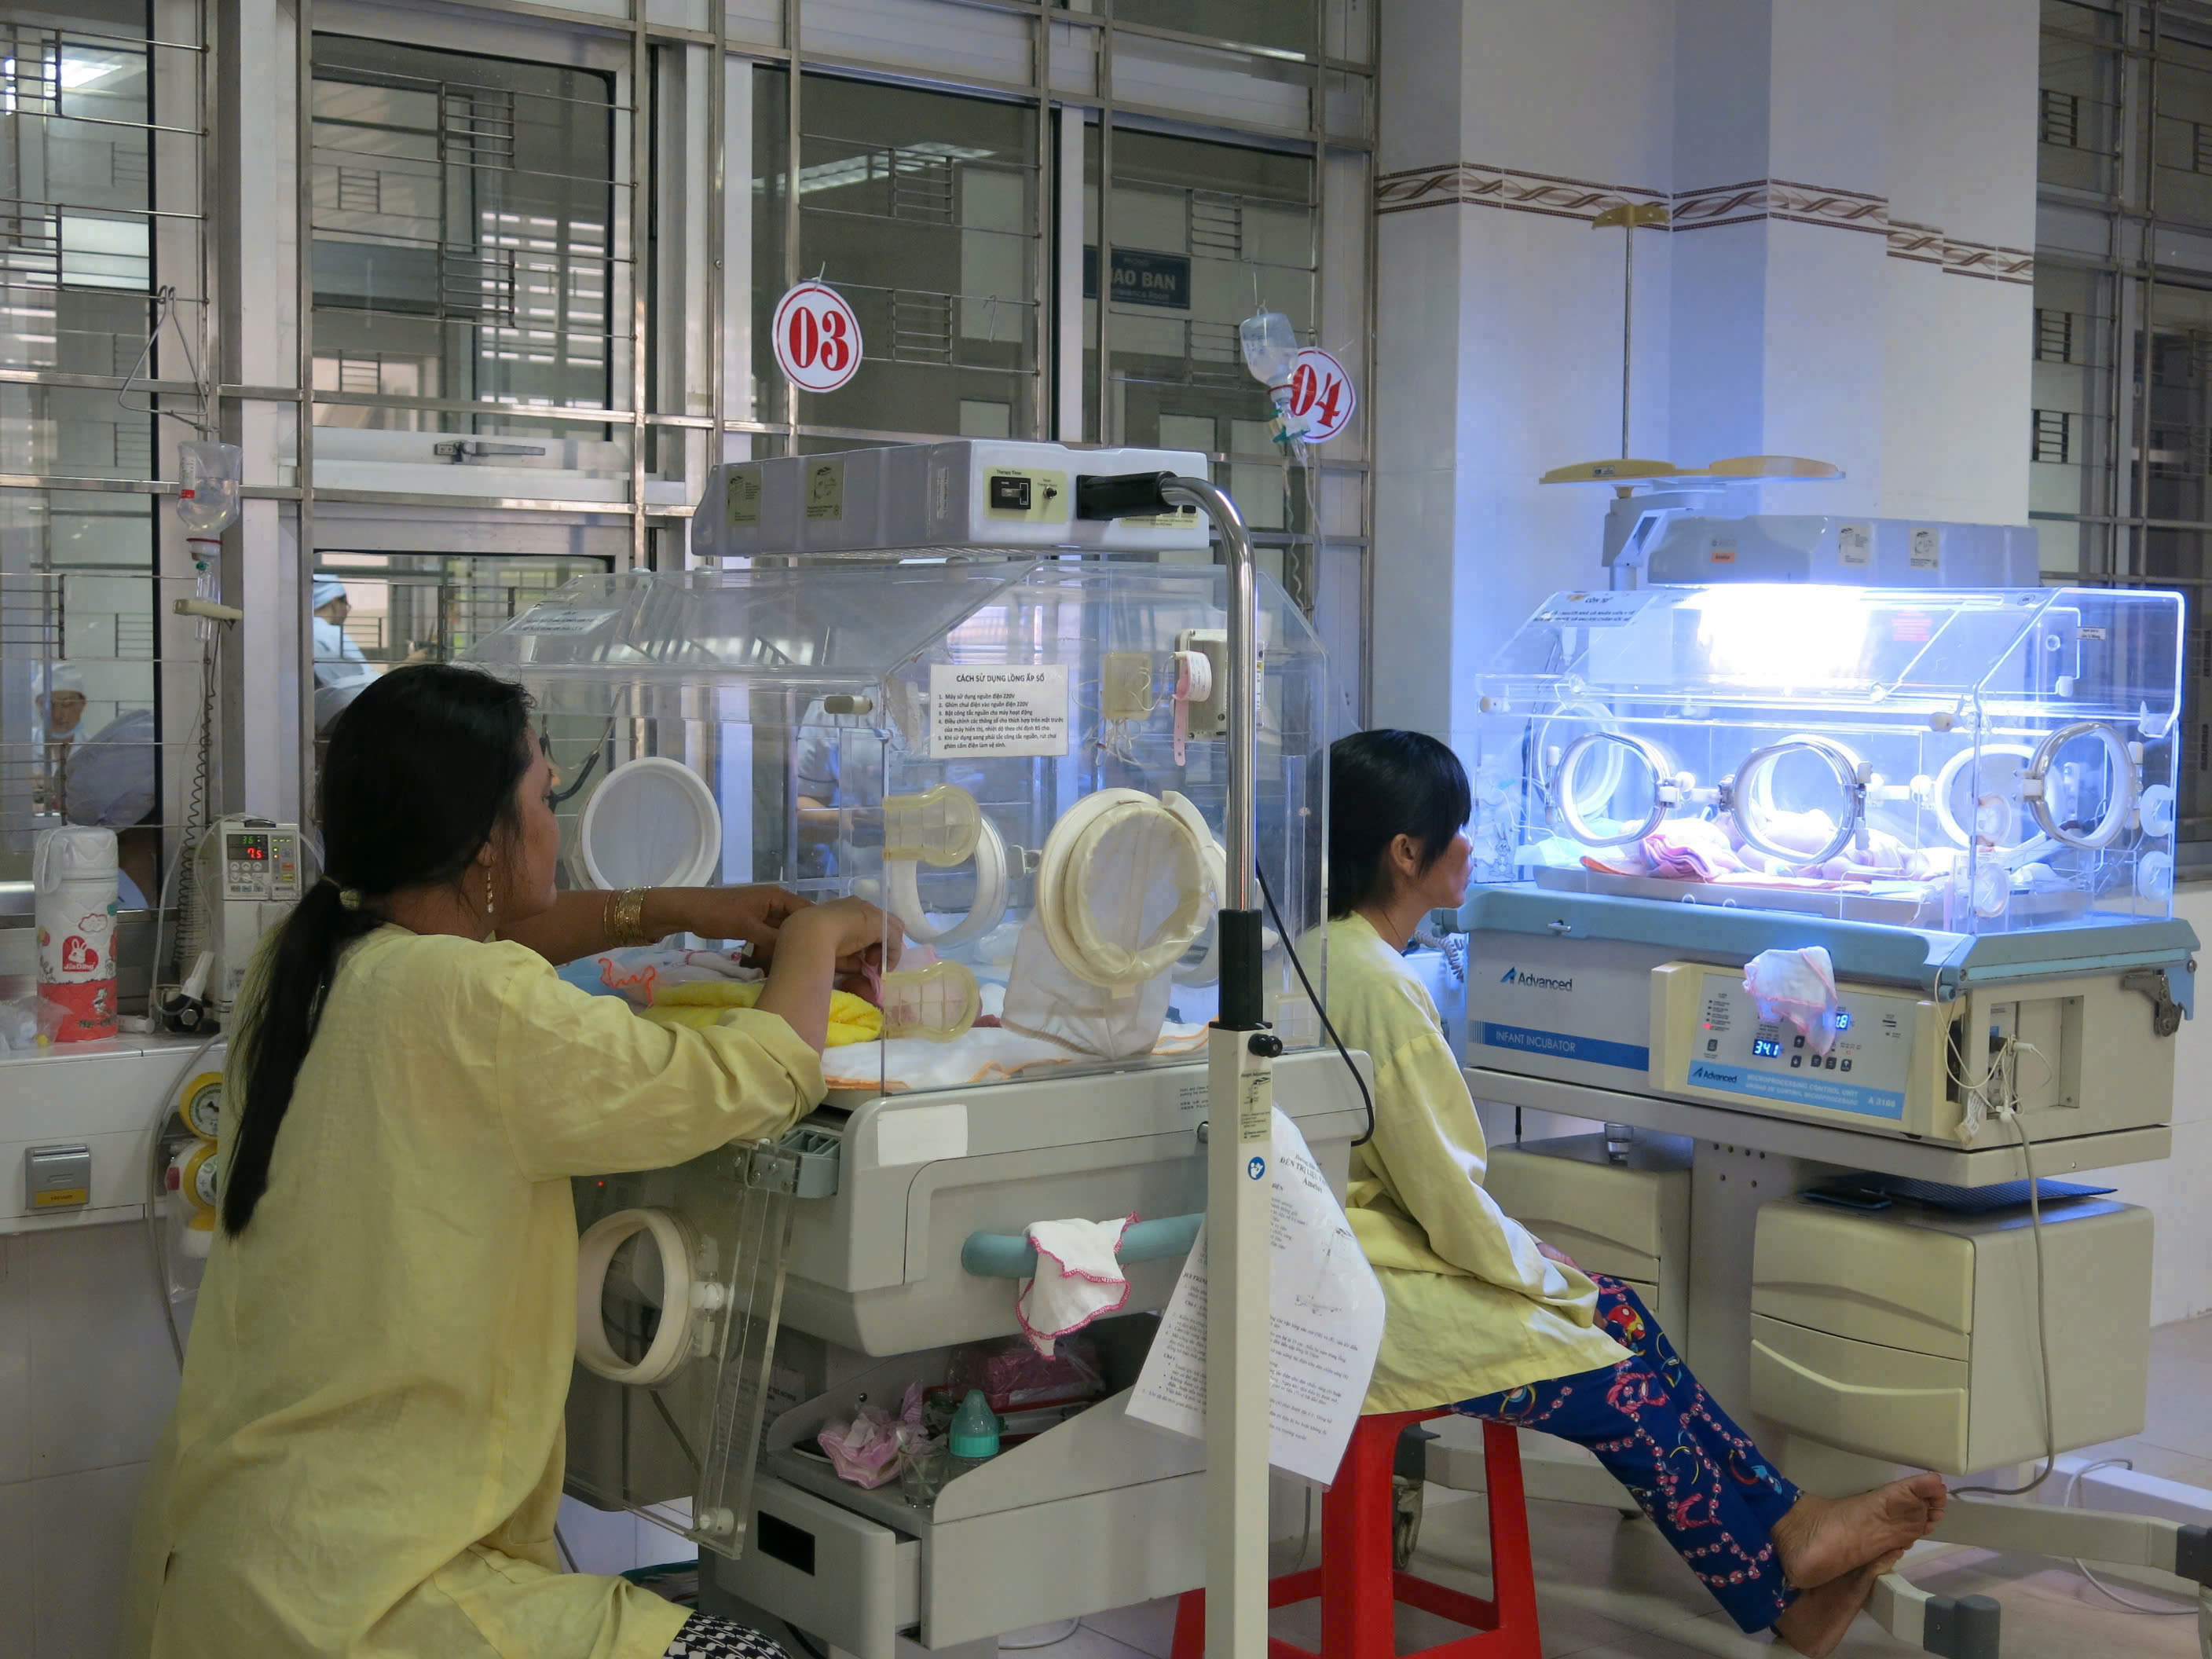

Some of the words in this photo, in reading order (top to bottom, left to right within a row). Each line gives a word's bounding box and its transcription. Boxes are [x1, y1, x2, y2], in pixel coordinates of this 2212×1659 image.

[1111, 269, 1136, 286] AO
[1141, 272, 1175, 290] BAN
[789, 307, 849, 371] 03
[1290, 364, 1342, 428] 04
[976, 673, 986, 682] SỬ
[1036, 673, 1045, 682] SỐ
[1518, 972, 1573, 991] Advanced
[1496, 1031, 1525, 1045] INFANT
[1526, 1036, 1577, 1053] INCUBATOR
[1703, 1069, 1738, 1083] Advanced
[1809, 1082, 1840, 1095] CONTROL
[1842, 1089, 1859, 1097] UNIT
